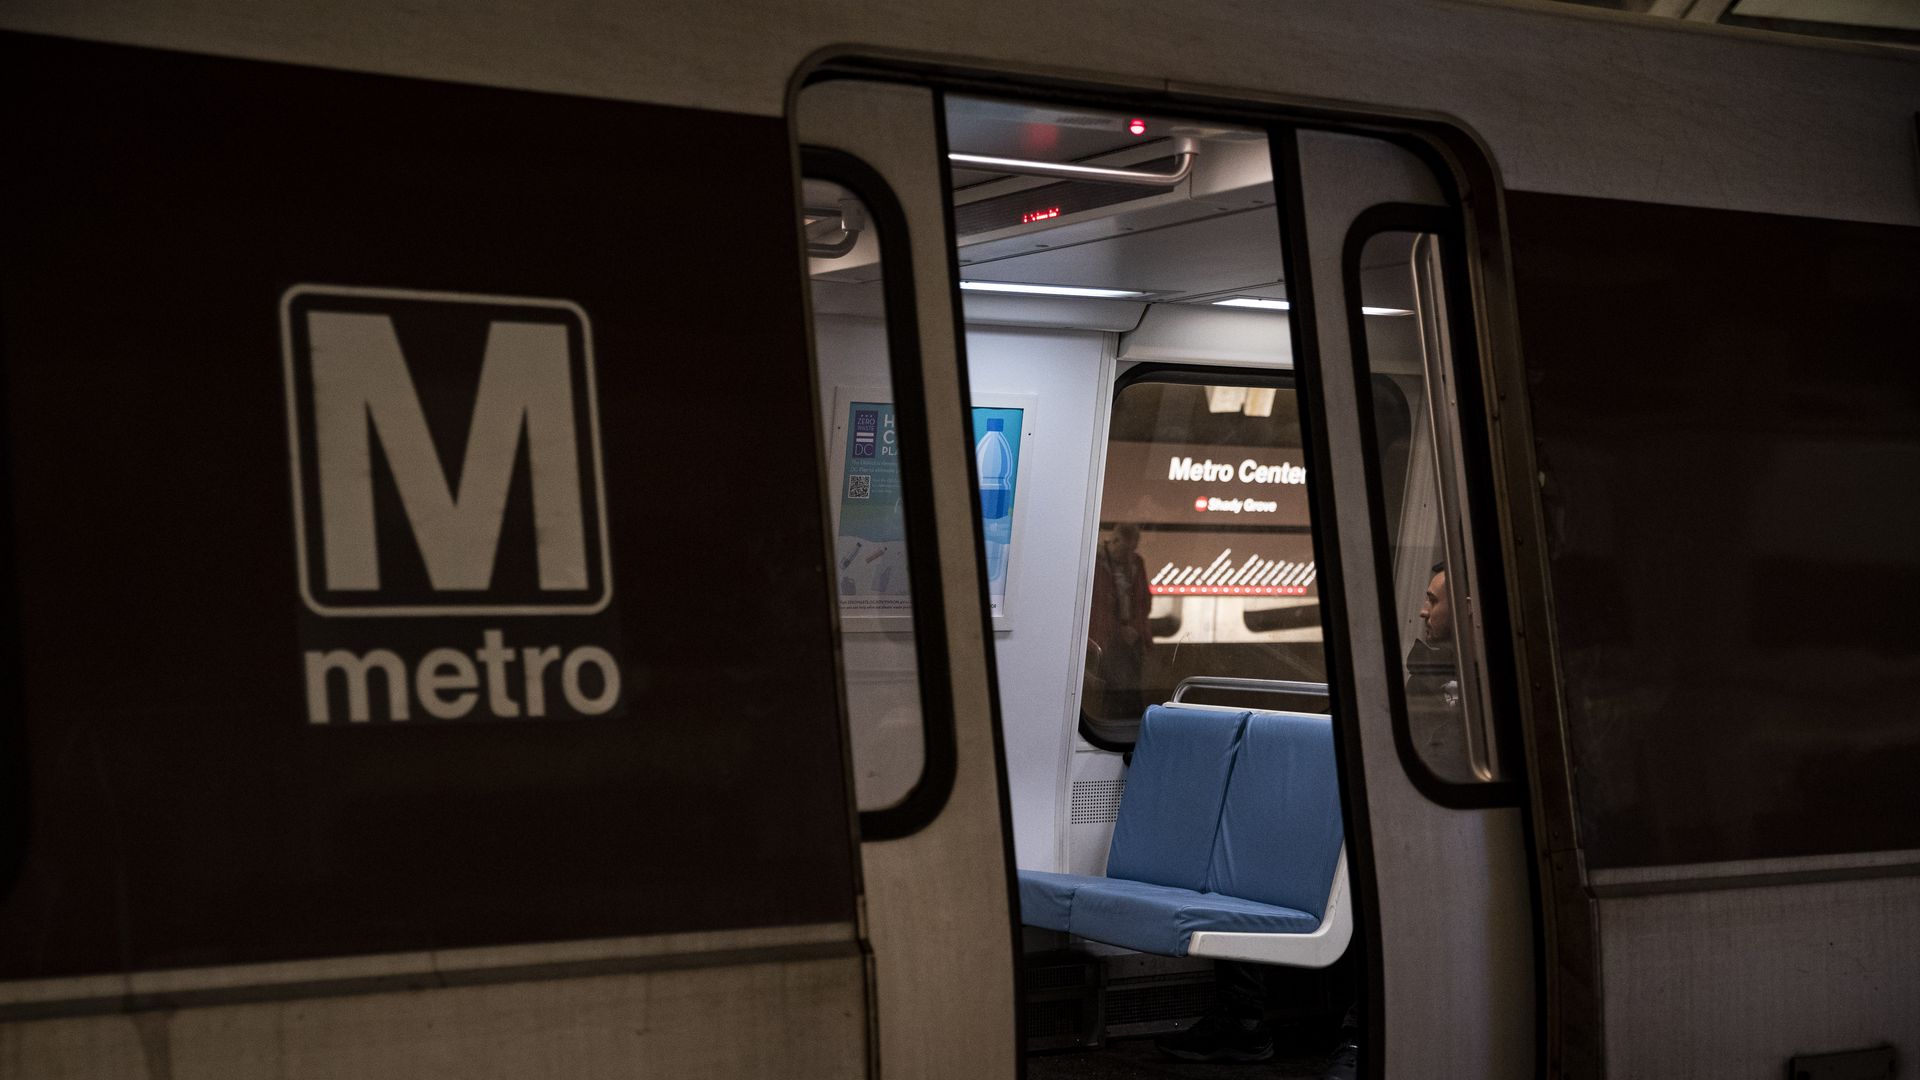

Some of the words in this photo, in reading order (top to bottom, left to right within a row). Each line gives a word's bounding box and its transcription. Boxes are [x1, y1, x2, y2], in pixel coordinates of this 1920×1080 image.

[305, 310, 590, 592] M
[855, 443, 874, 455] DC
[1168, 456, 1234, 482] Metro
[1238, 459, 1306, 485] Center
[303, 629, 623, 725] metro
